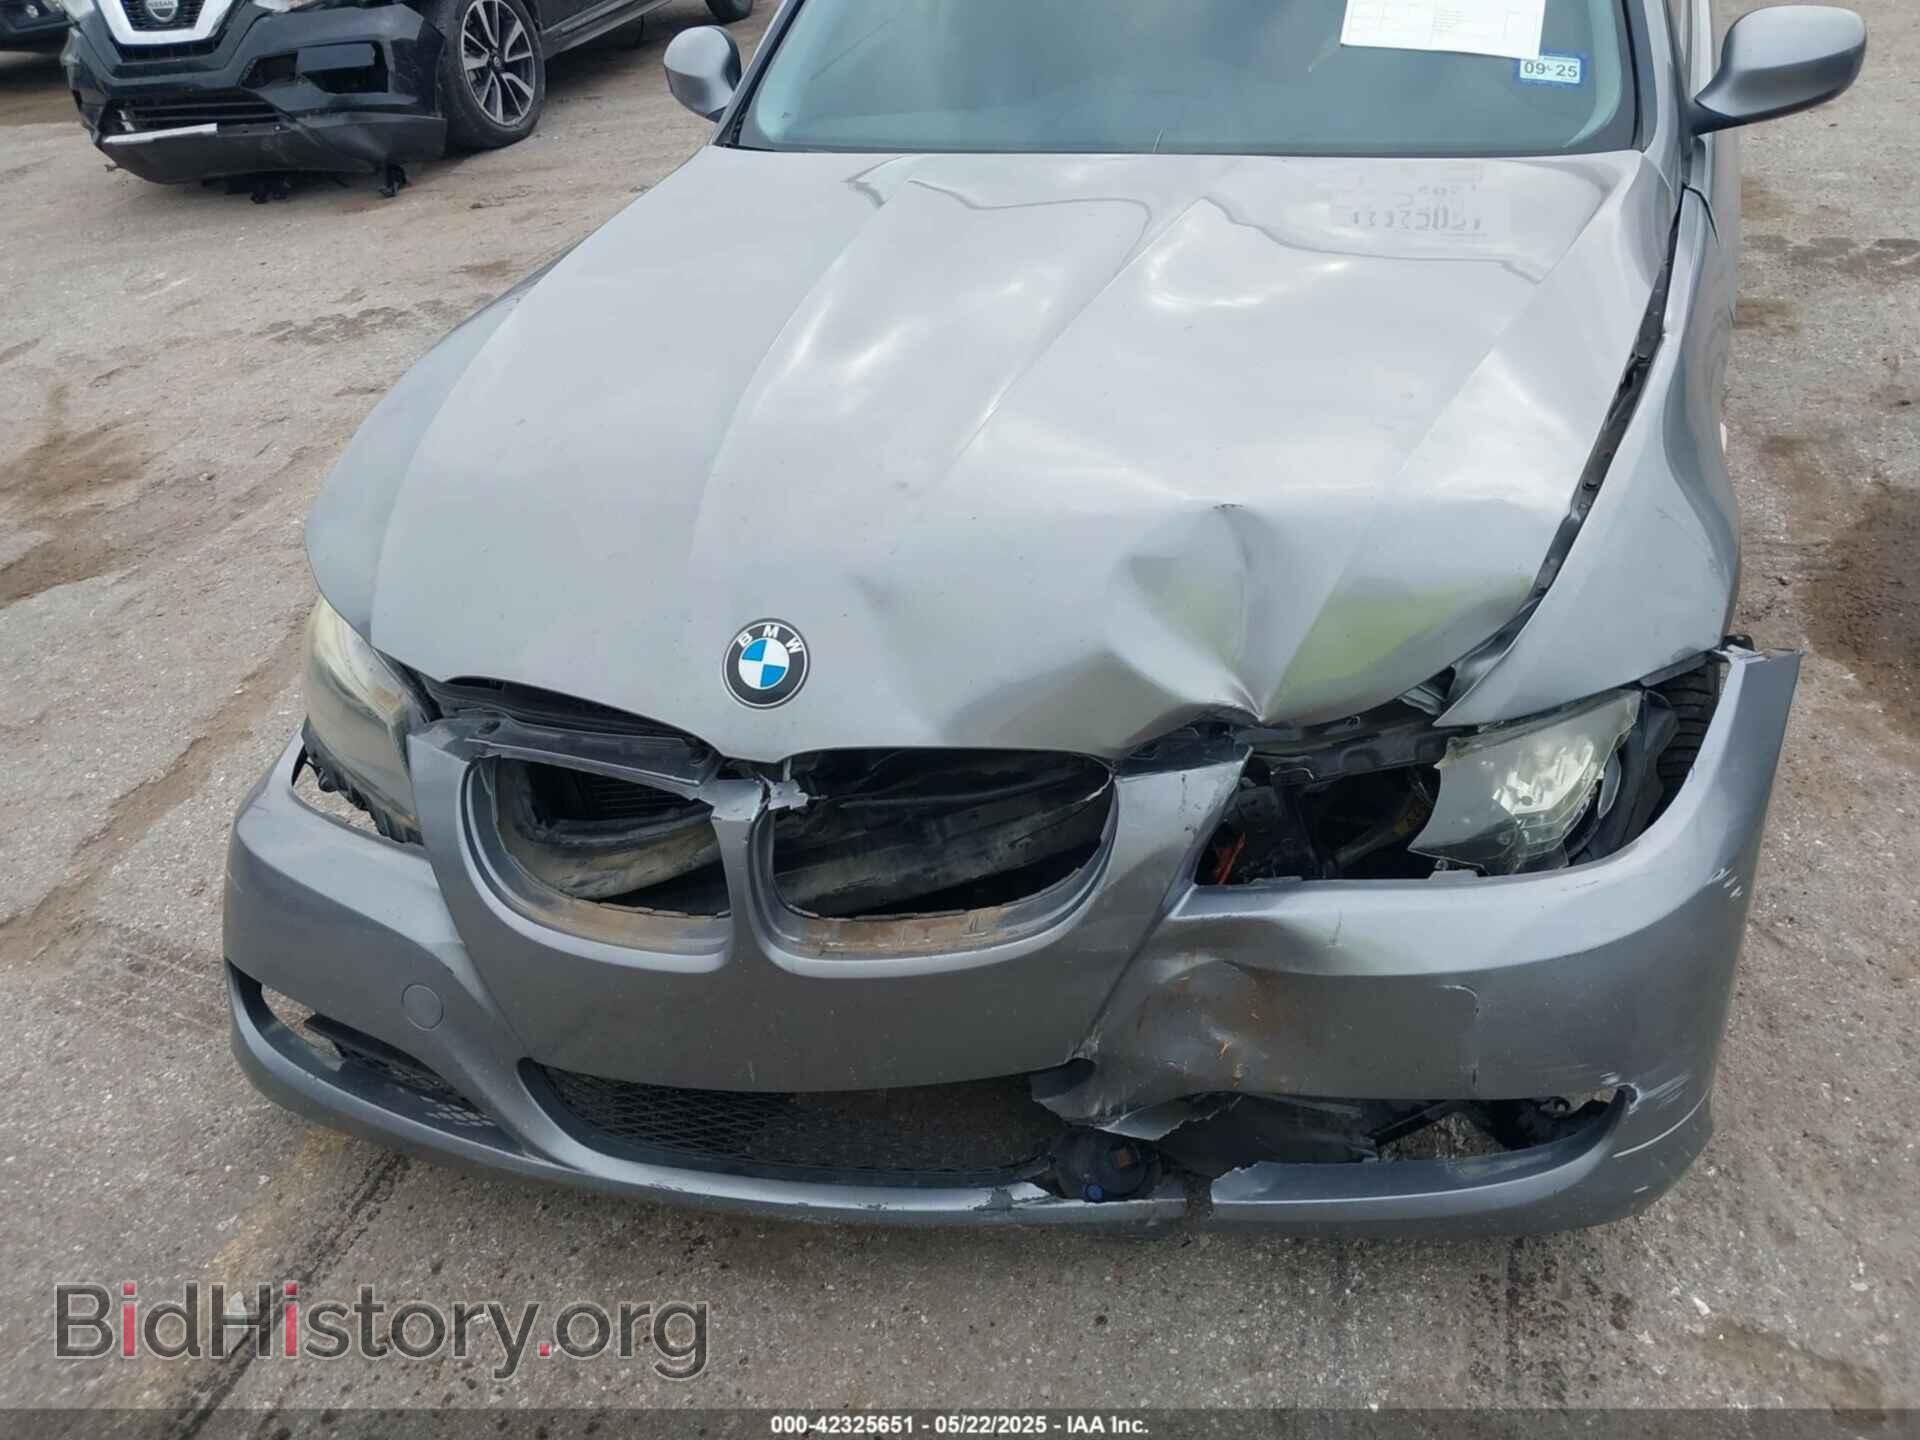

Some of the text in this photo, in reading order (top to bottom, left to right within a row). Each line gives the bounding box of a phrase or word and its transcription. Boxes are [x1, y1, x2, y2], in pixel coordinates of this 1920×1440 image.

[1524, 62, 1546, 75] 09
[1556, 64, 1577, 78] 25
[737, 624, 803, 654] BMW
